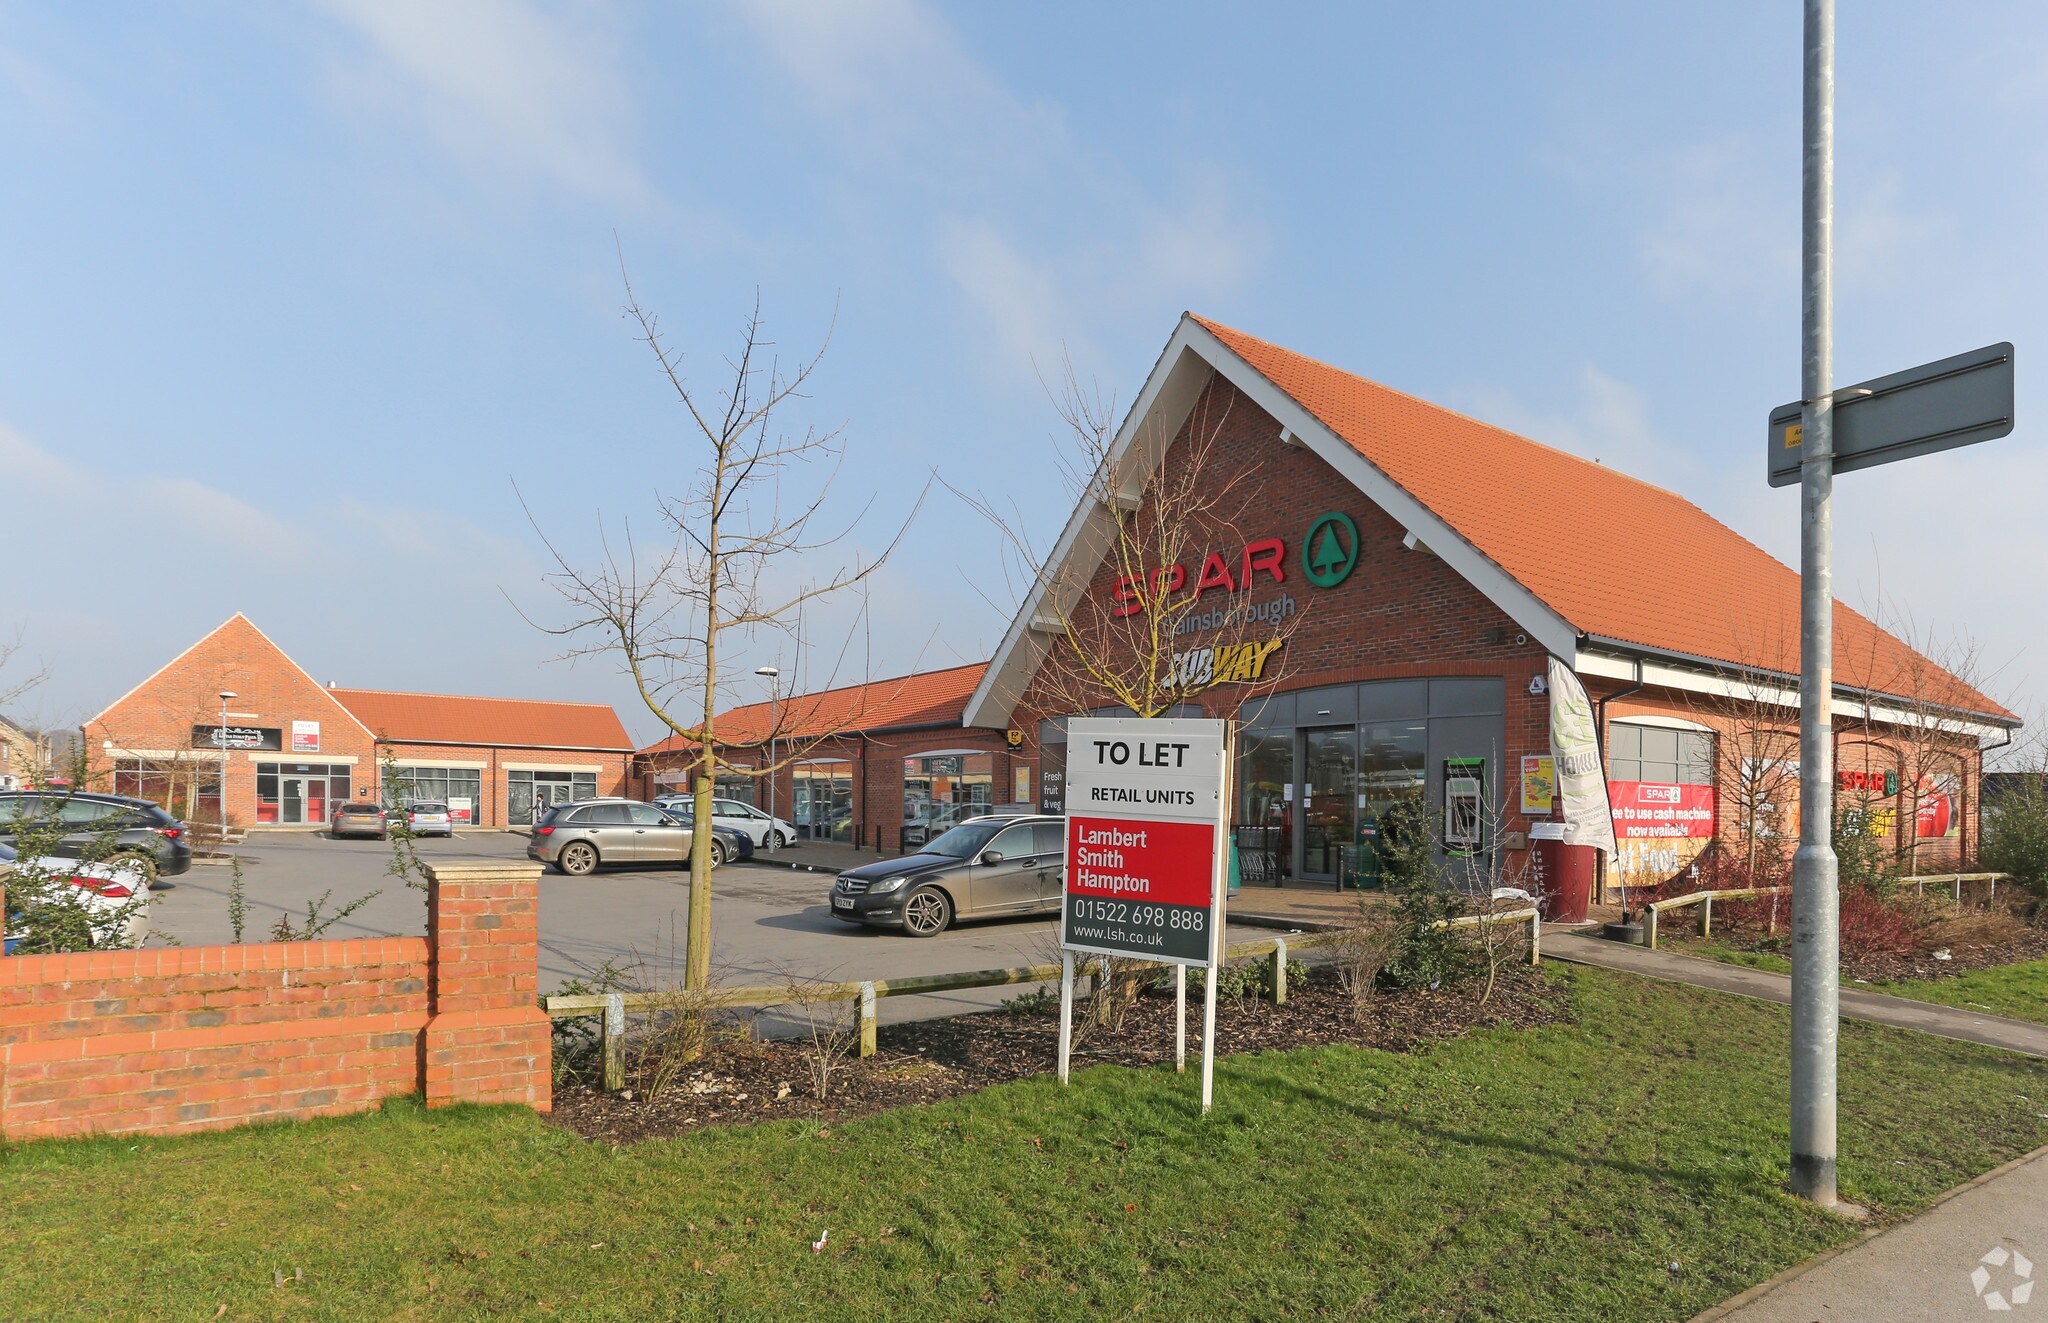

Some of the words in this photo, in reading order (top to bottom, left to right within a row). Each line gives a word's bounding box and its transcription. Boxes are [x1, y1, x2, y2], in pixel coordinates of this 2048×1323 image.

[1113, 537, 1286, 617] SPAR
[1161, 638, 1283, 689] SUBWAY
[1093, 741, 1130, 765] TO
[1139, 742, 1189, 767] LET
[1044, 771, 1062, 781] Fresh
[1838, 771, 1885, 791] SPAR
[1044, 785, 1058, 795] fruit
[1092, 787, 1141, 802] RETAIL
[1146, 790, 1194, 805] UNITS
[1646, 789, 1671, 799] SPAR
[1044, 800, 1050, 808] &
[1050, 801, 1061, 811] veg
[1612, 808, 1623, 819] ee
[1624, 806, 1634, 819] to
[1637, 809, 1652, 819] use
[1653, 806, 1675, 820] cash
[1675, 806, 1711, 820] machine
[1078, 825, 1147, 848] Lambert
[1627, 825, 1647, 837] now
[1648, 823, 1688, 837] available
[1077, 847, 1124, 869] Smith
[1077, 868, 1149, 894] Hampton
[1075, 899, 1127, 923] 01522
[1132, 905, 1164, 927] 698
[1170, 909, 1204, 931] 888
[1074, 925, 1163, 946] www.lsh.co.uk
